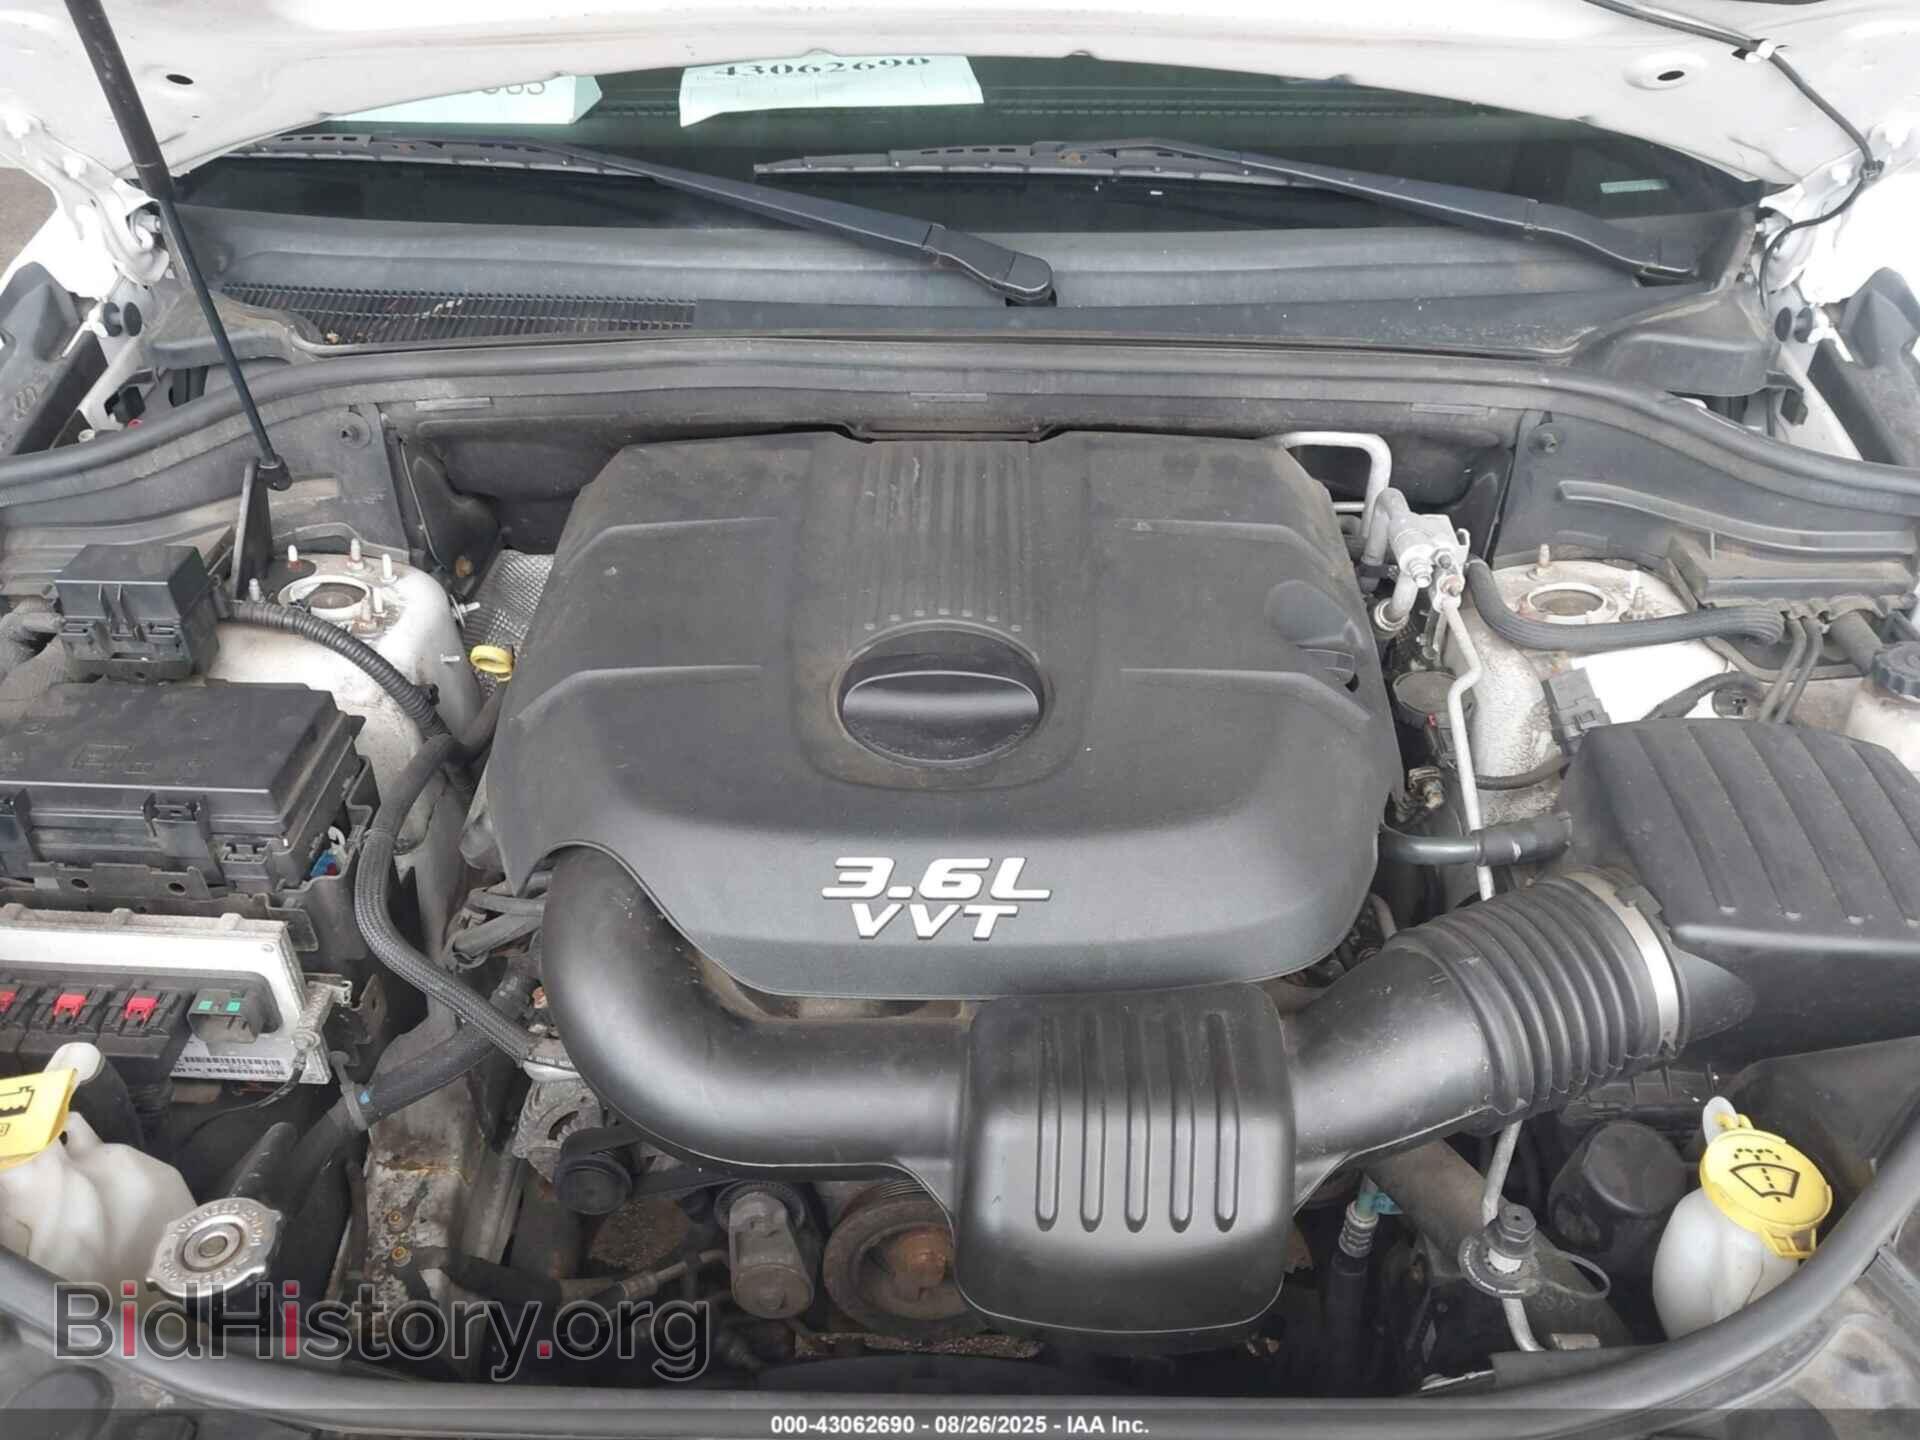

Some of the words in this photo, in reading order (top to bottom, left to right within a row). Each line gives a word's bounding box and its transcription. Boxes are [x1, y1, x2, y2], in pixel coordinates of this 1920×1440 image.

[714, 56, 931, 77] 43062690
[822, 857, 1051, 900] 3.6L
[851, 903, 1019, 940] VVT
